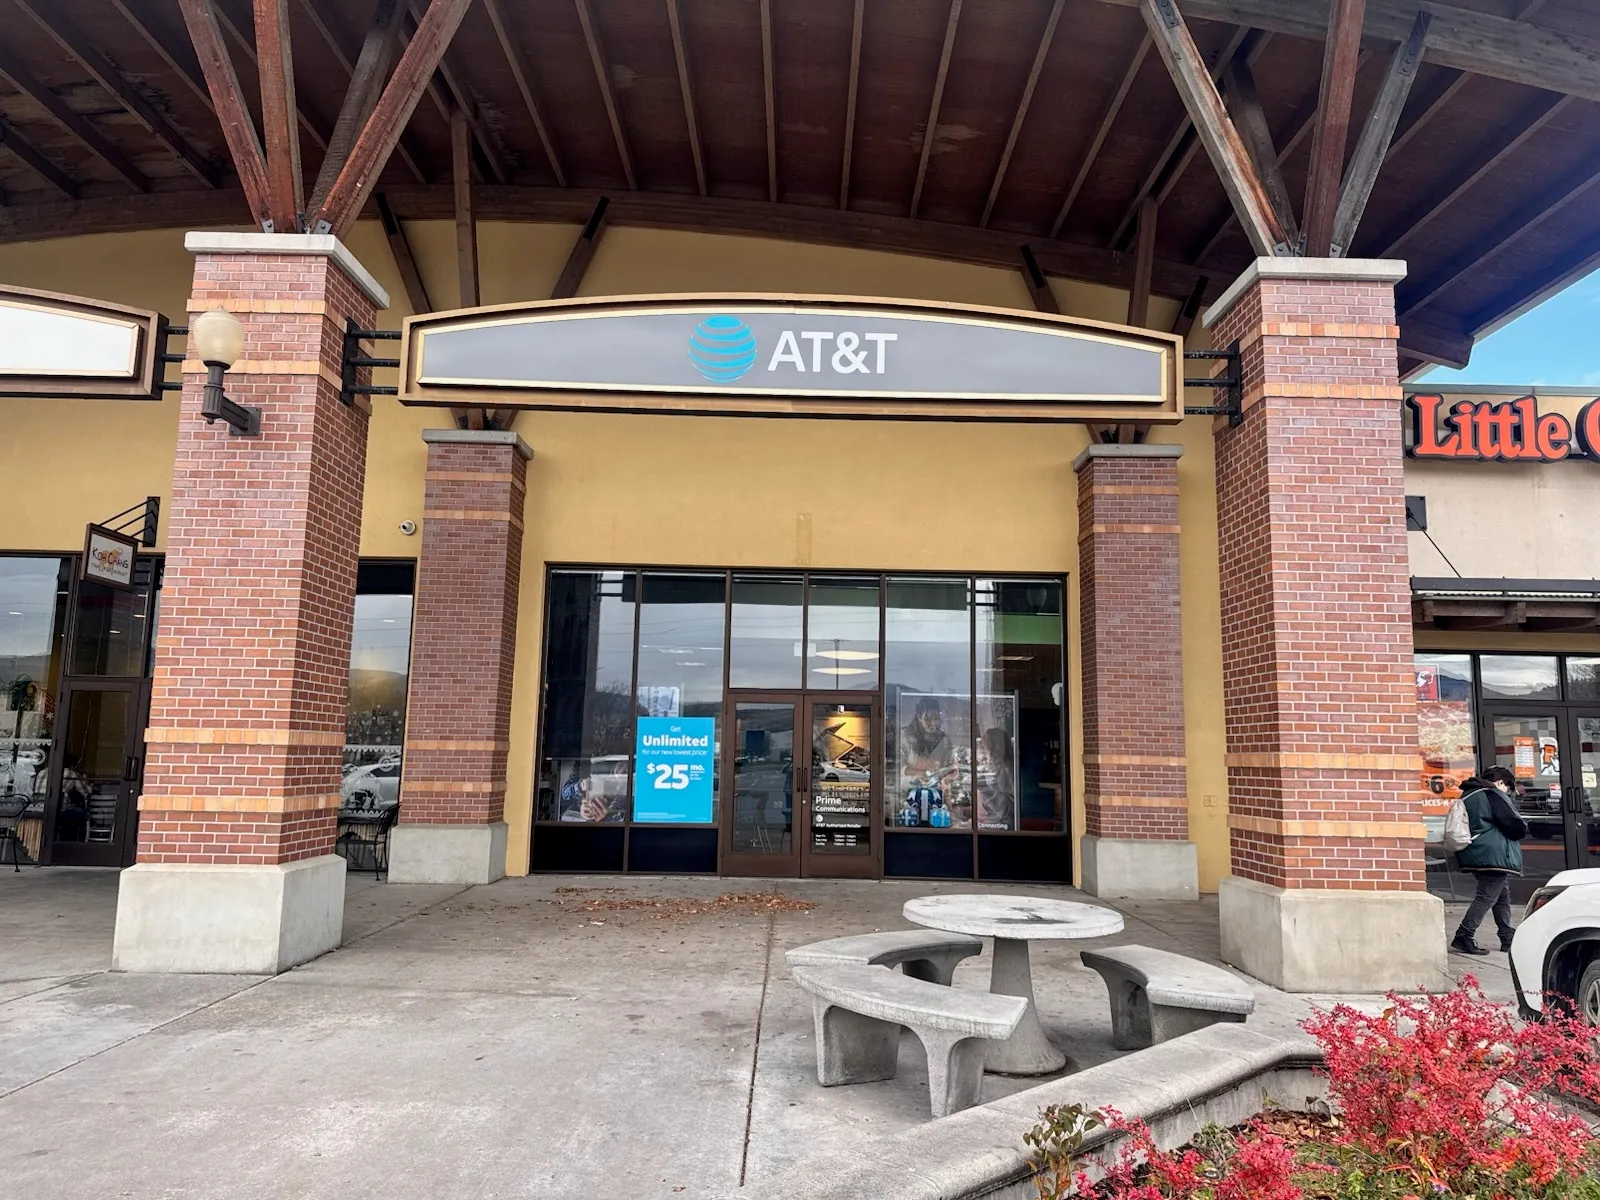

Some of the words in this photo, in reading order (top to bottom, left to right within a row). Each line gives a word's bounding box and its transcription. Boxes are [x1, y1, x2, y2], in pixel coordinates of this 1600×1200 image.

[767, 330, 898, 374] AT&T
[1412, 395, 1571, 460] Little
[670, 725, 682, 733] Get
[643, 734, 708, 747] Unlimited
[646, 762, 690, 790] $25
[815, 795, 842, 805] Prime
[815, 805, 866, 813] Communications
[978, 822, 1008, 830] Connecting
